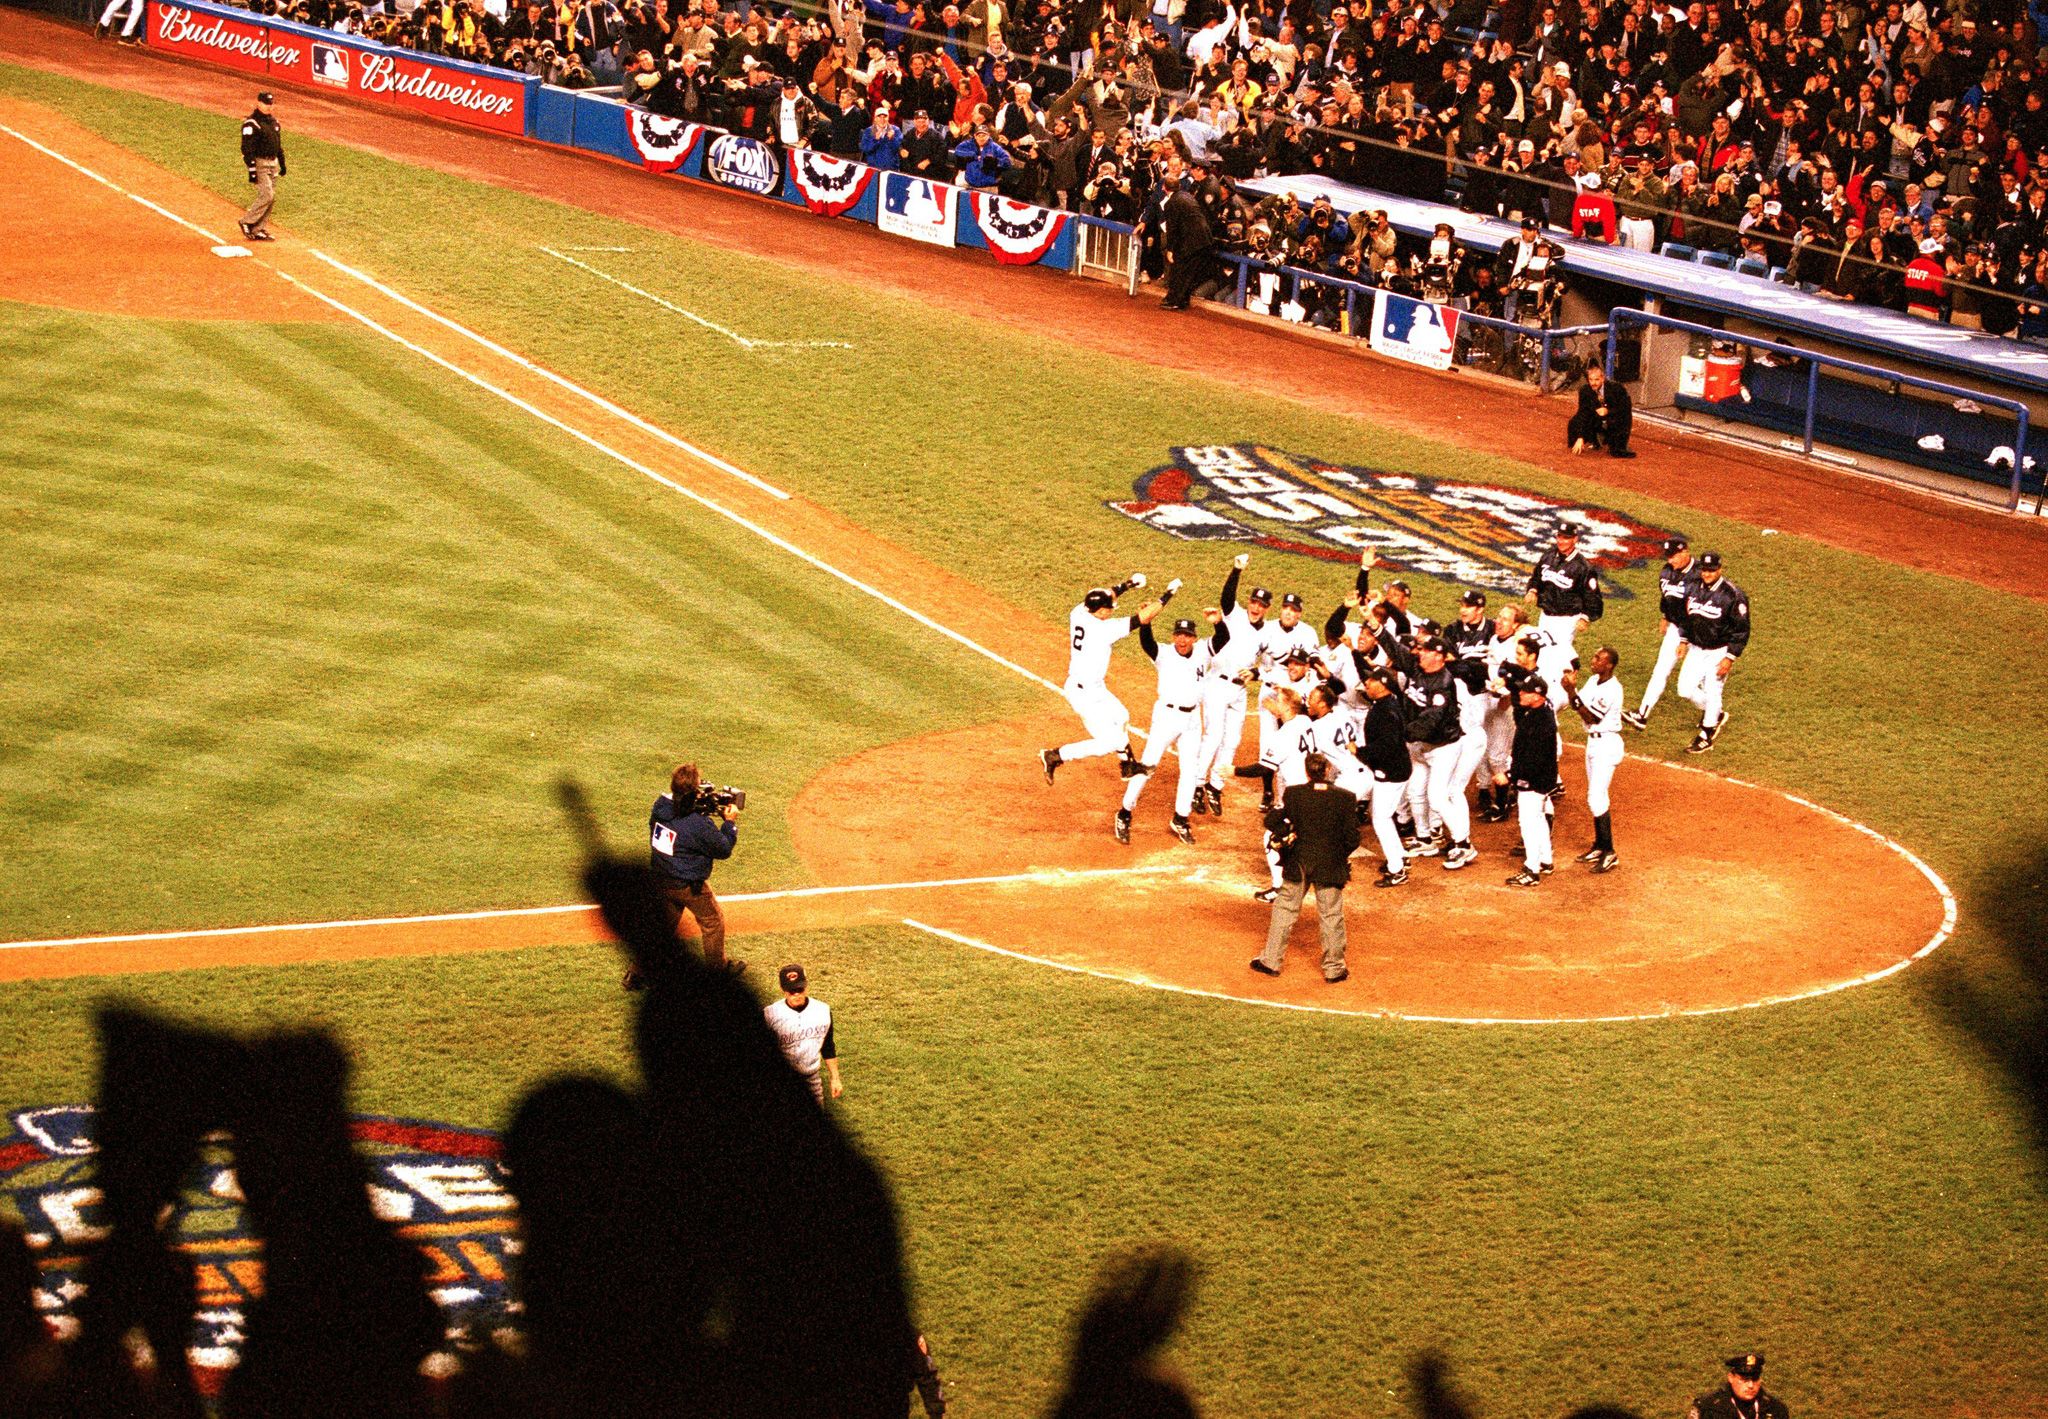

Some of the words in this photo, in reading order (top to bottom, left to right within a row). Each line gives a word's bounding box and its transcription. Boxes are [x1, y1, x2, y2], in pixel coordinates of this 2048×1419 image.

[159, 3, 300, 66] Budweiser
[360, 52, 514, 116] Budweiser
[723, 138, 765, 178] FOX
[720, 172, 764, 191] SPORTS
[1907, 268, 1929, 281] STAFF
[1073, 625, 1085, 651] 2
[1298, 727, 1318, 755] 47
[1333, 722, 1357, 747] 42
